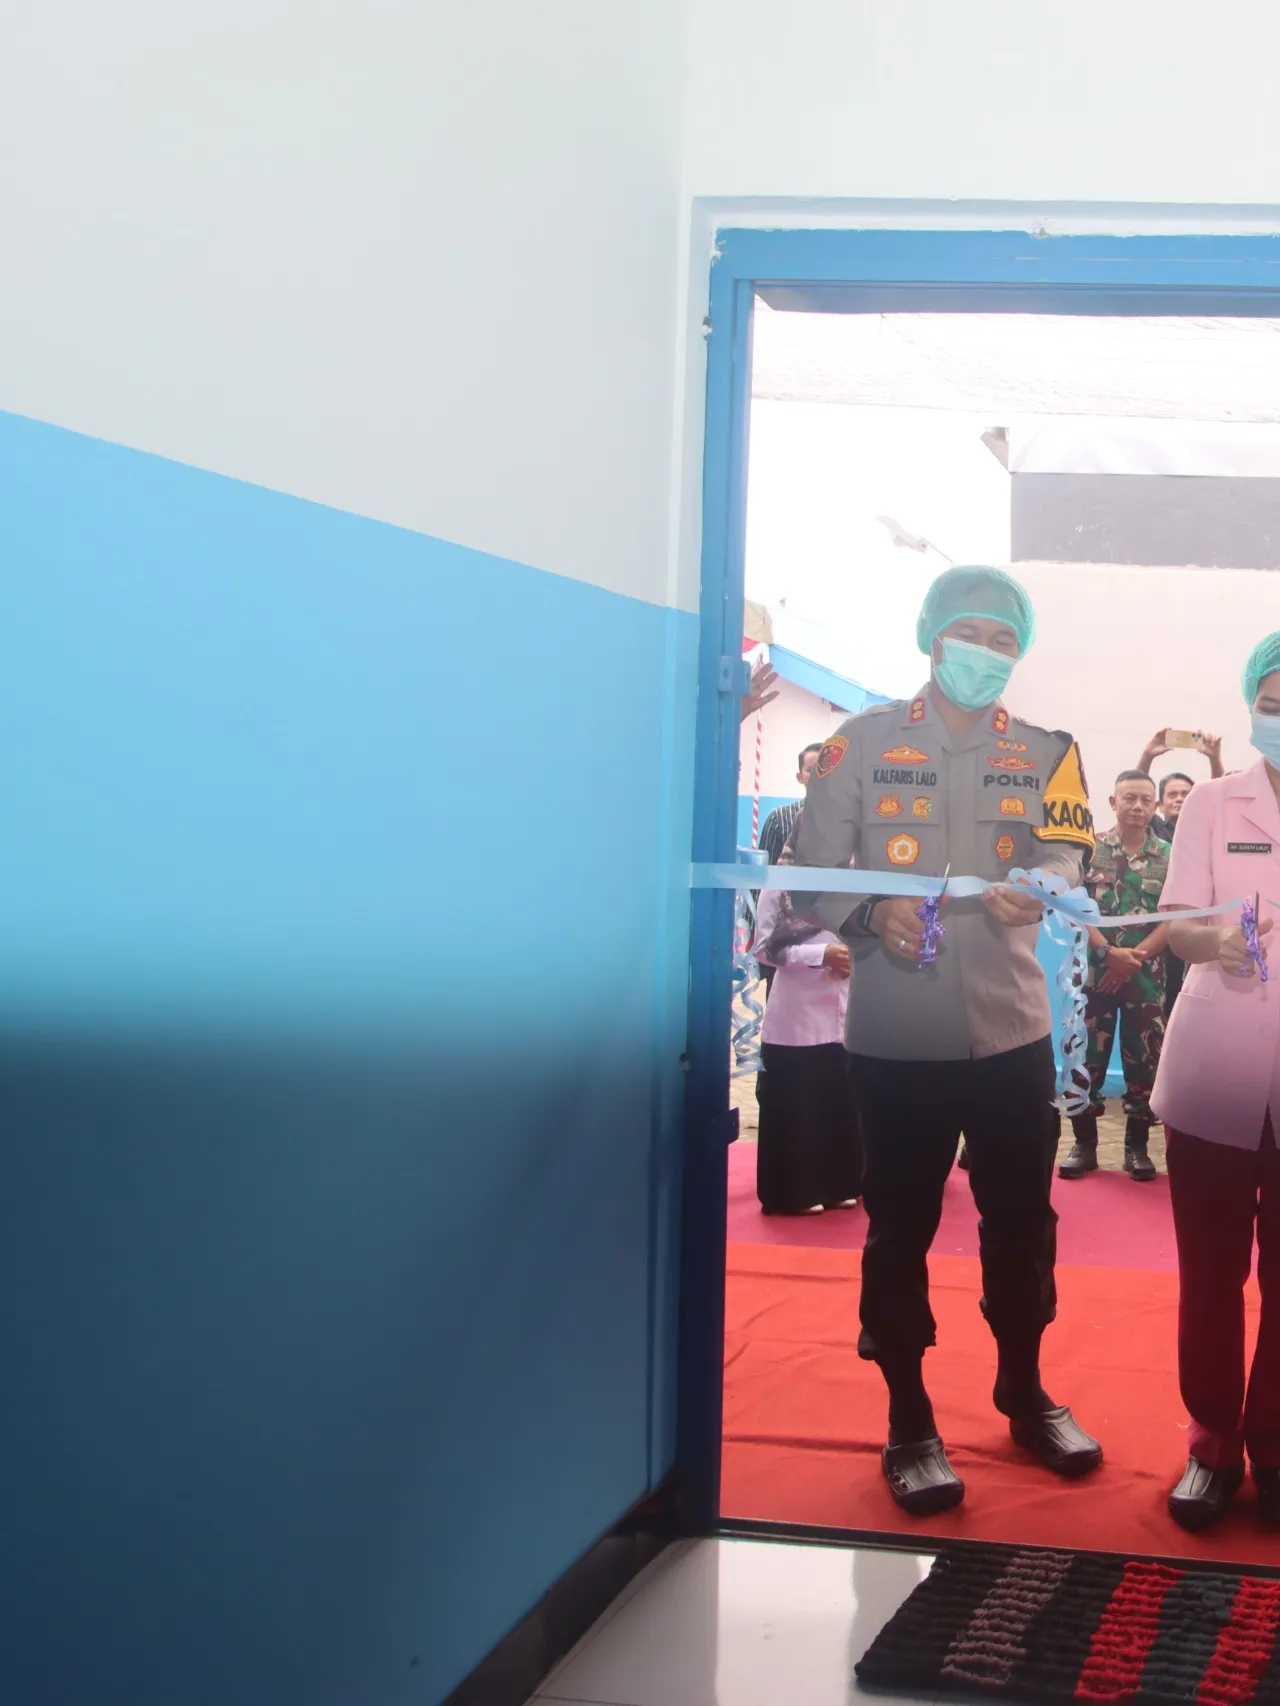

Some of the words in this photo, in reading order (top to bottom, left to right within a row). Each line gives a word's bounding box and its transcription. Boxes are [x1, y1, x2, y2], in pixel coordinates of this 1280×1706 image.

[873, 768, 914, 784] KALFARIS
[915, 771, 937, 787] LALO
[983, 774, 1040, 790] POLRI
[1043, 800, 1093, 833] KAOP
